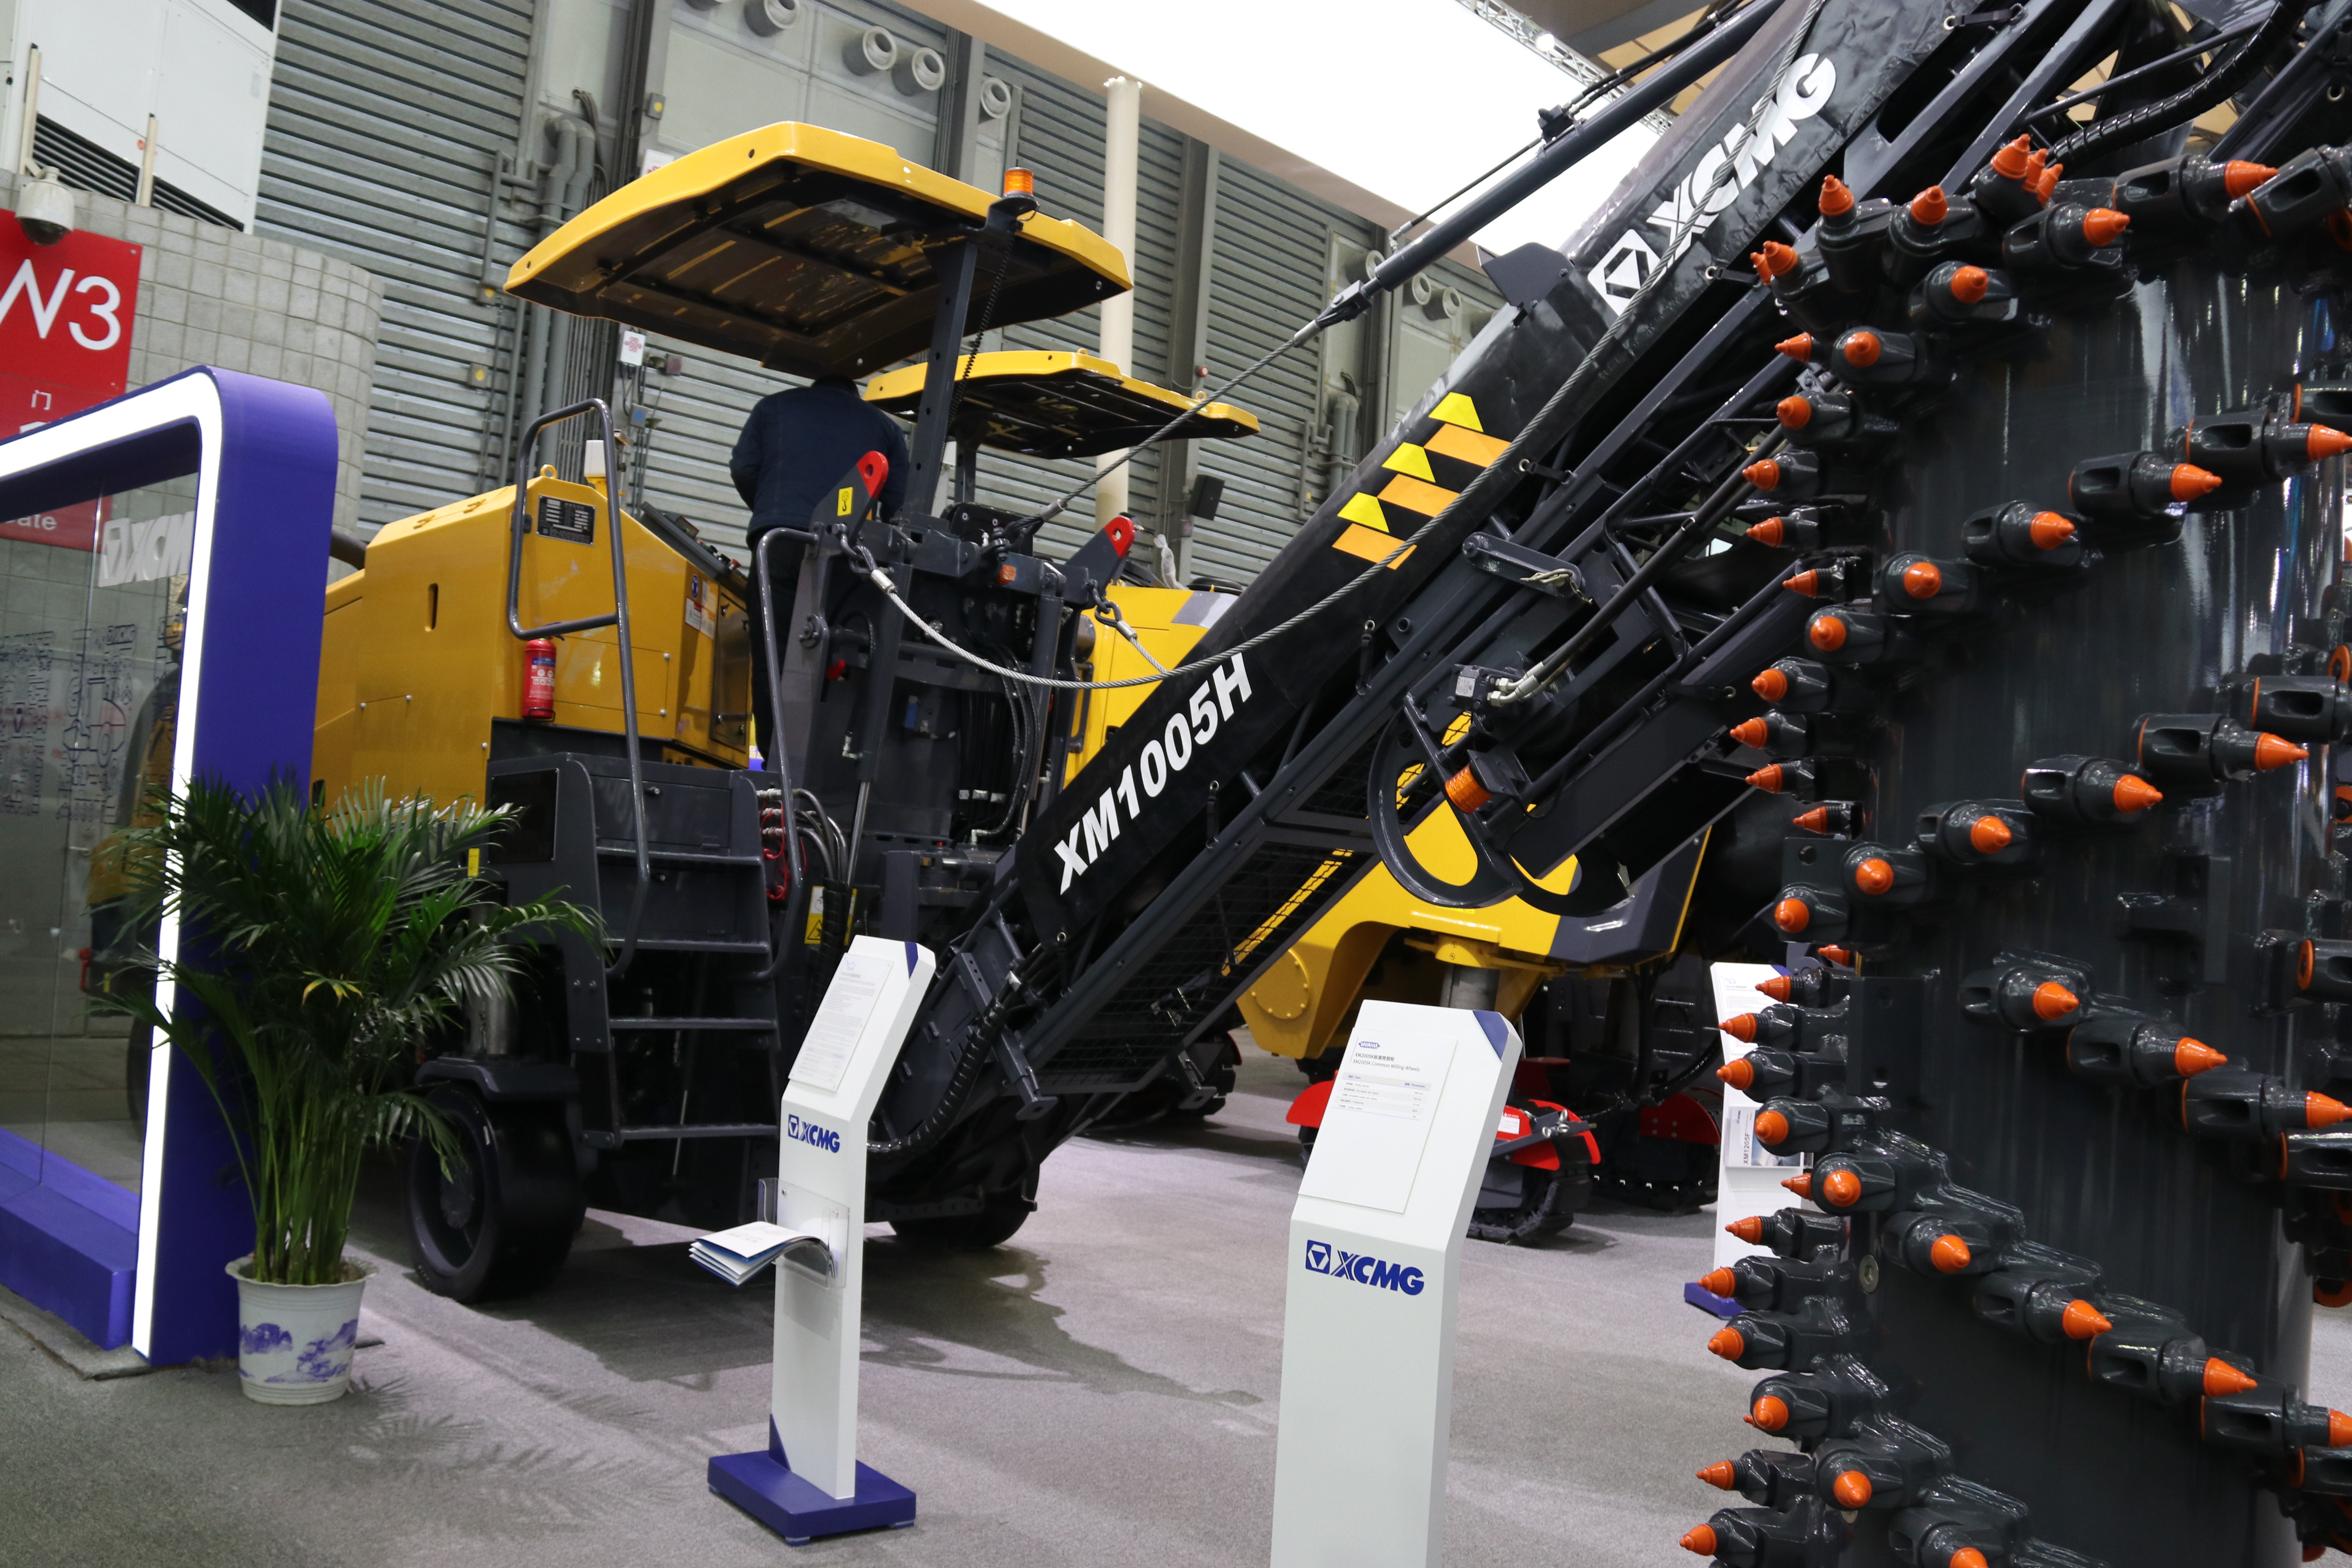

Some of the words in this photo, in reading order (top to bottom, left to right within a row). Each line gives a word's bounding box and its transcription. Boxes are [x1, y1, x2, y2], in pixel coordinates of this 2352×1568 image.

[1646, 53, 1836, 268] XCMG
[6, 514, 57, 531] ate
[1054, 652, 1252, 895] XM1005H
[798, 1121, 840, 1153] XCMG
[1330, 1250, 1425, 1296] XCMG
